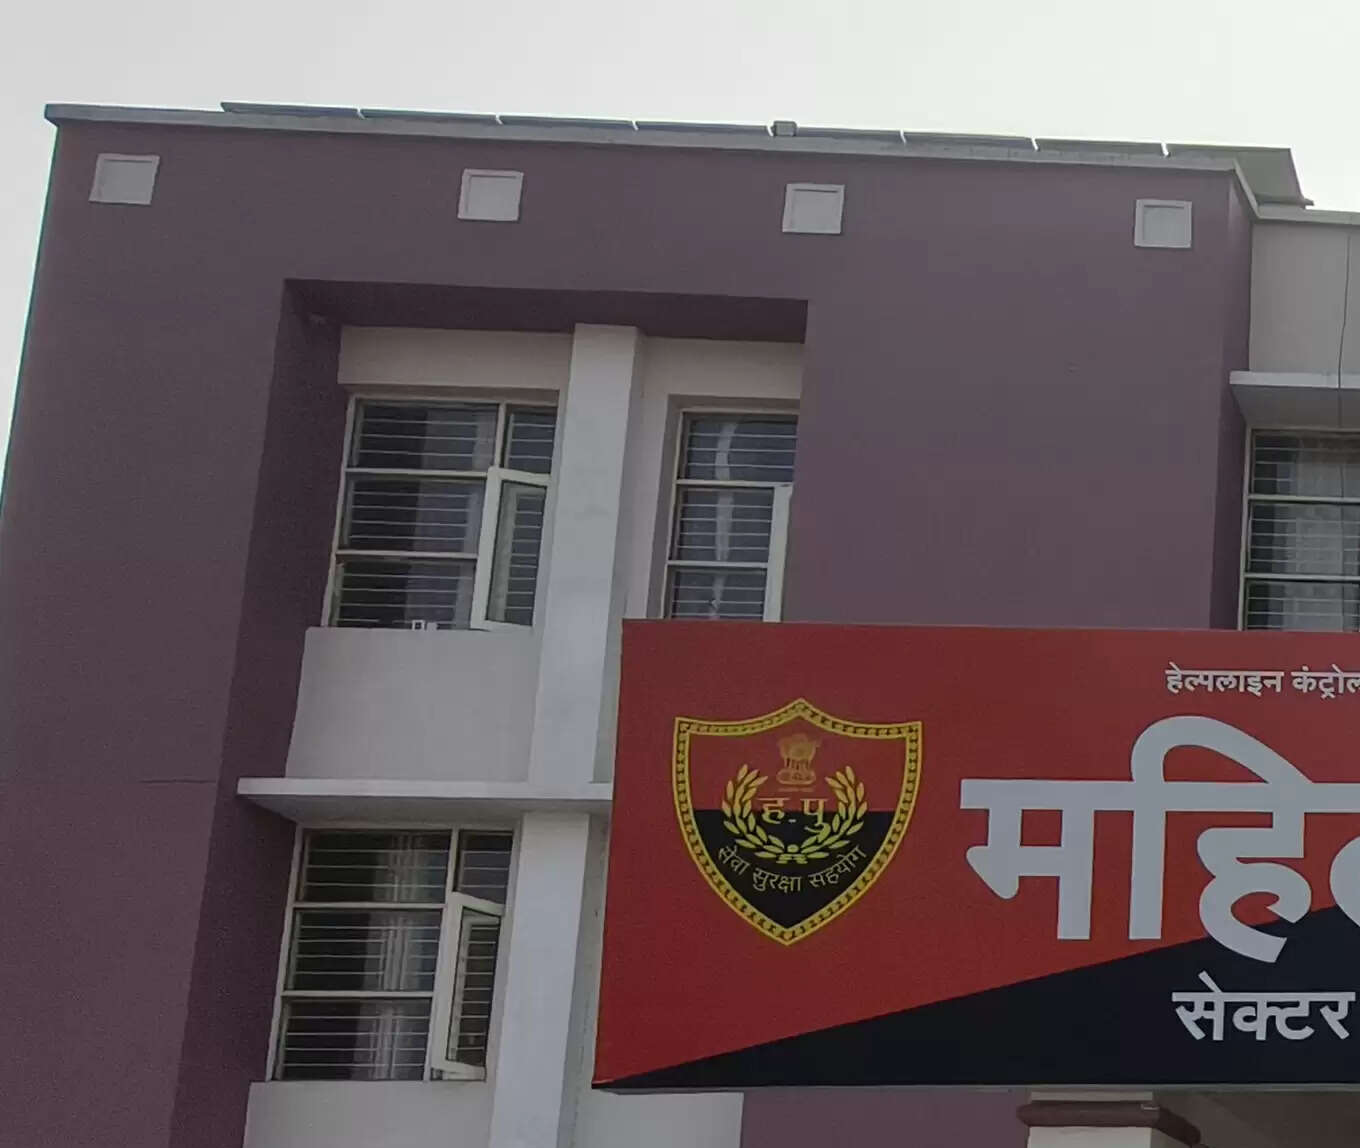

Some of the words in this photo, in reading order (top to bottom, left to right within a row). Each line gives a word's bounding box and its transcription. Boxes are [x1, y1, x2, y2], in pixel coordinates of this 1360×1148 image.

[1165, 662, 1285, 697] हेल्पलाइन
[718, 845, 750, 876] सेवा
[752, 867, 802, 893] सुरक्षा
[808, 845, 867, 888] सहयोग
[1172, 972, 1356, 1042] सेक्टर
